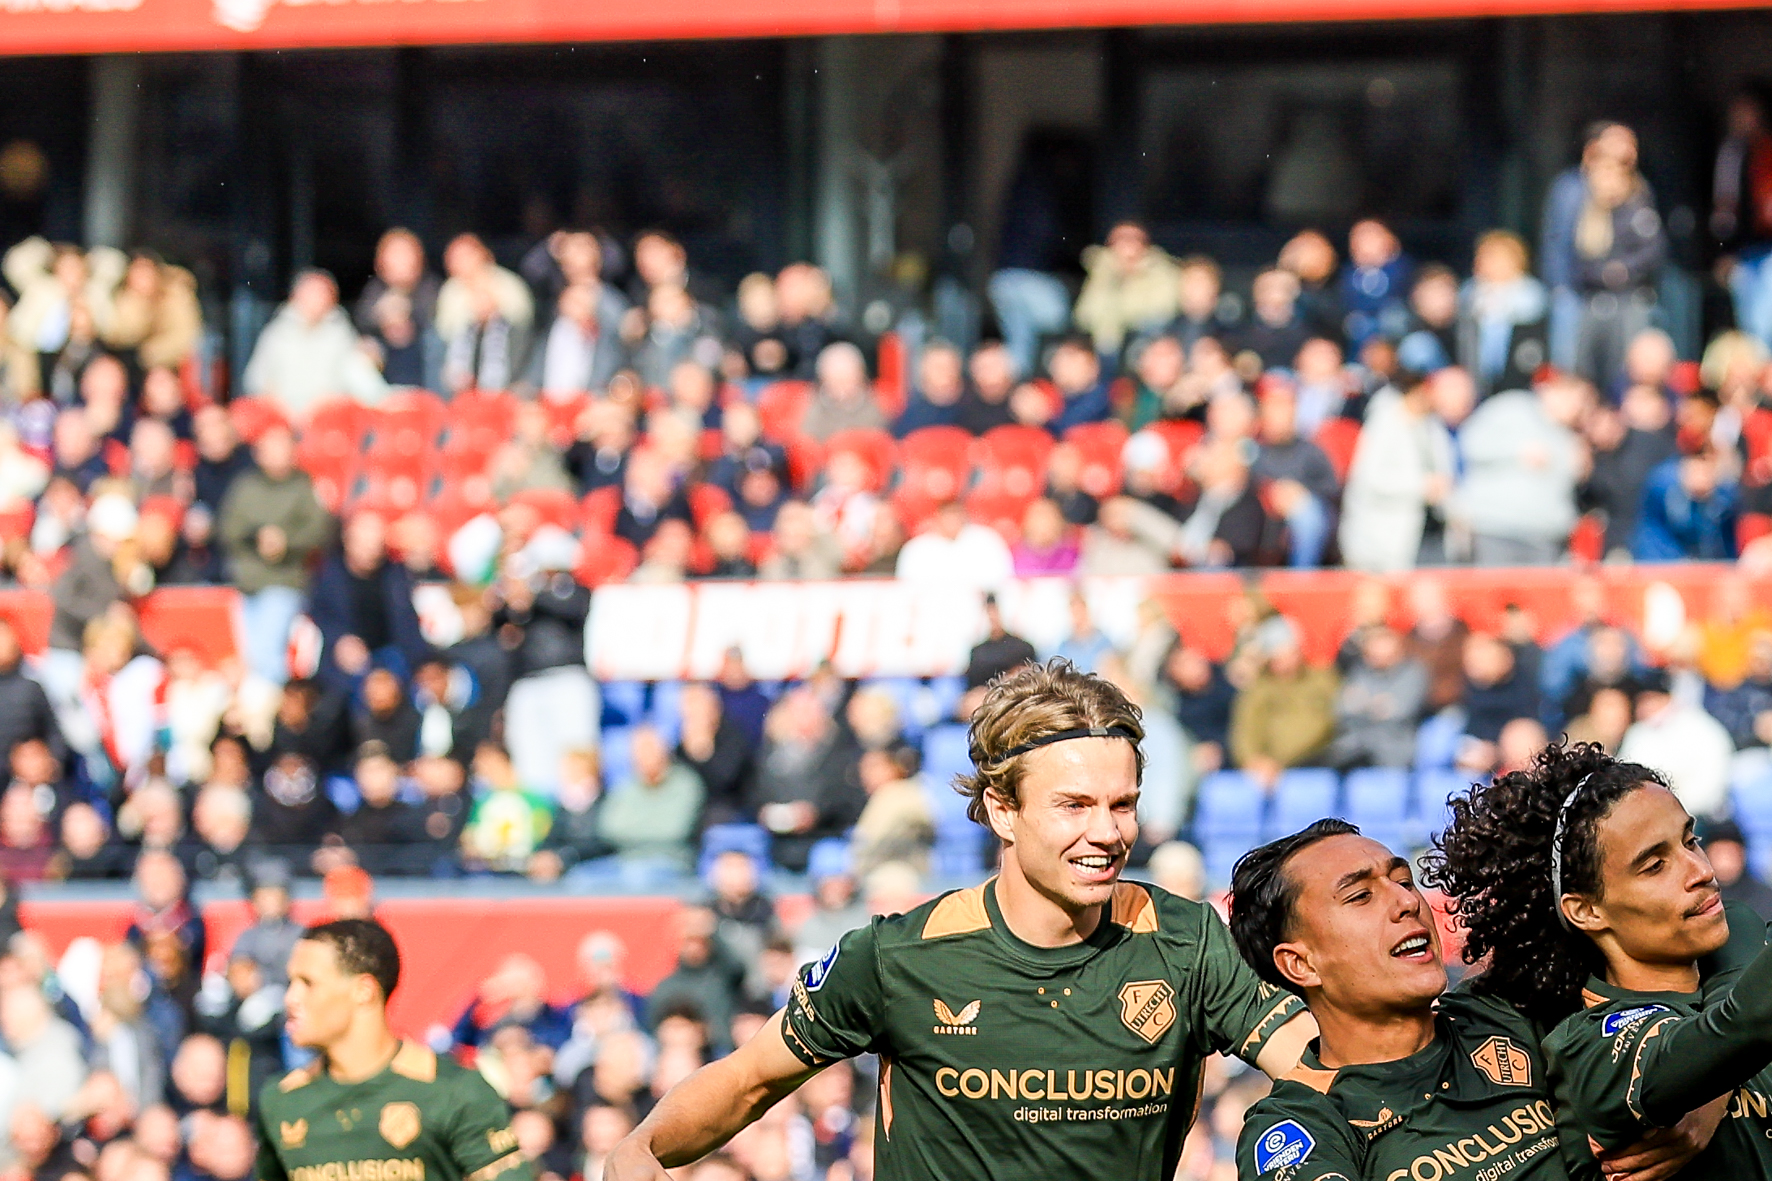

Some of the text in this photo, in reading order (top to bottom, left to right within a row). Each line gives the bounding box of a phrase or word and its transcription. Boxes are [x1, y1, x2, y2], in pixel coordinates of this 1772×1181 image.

[1131, 985, 1169, 1030] UTRECHT
[1496, 1040, 1513, 1083] UTRECHT
[935, 1066, 1175, 1101] CONCLUSION
[1013, 1102, 1168, 1123] digital transformation
